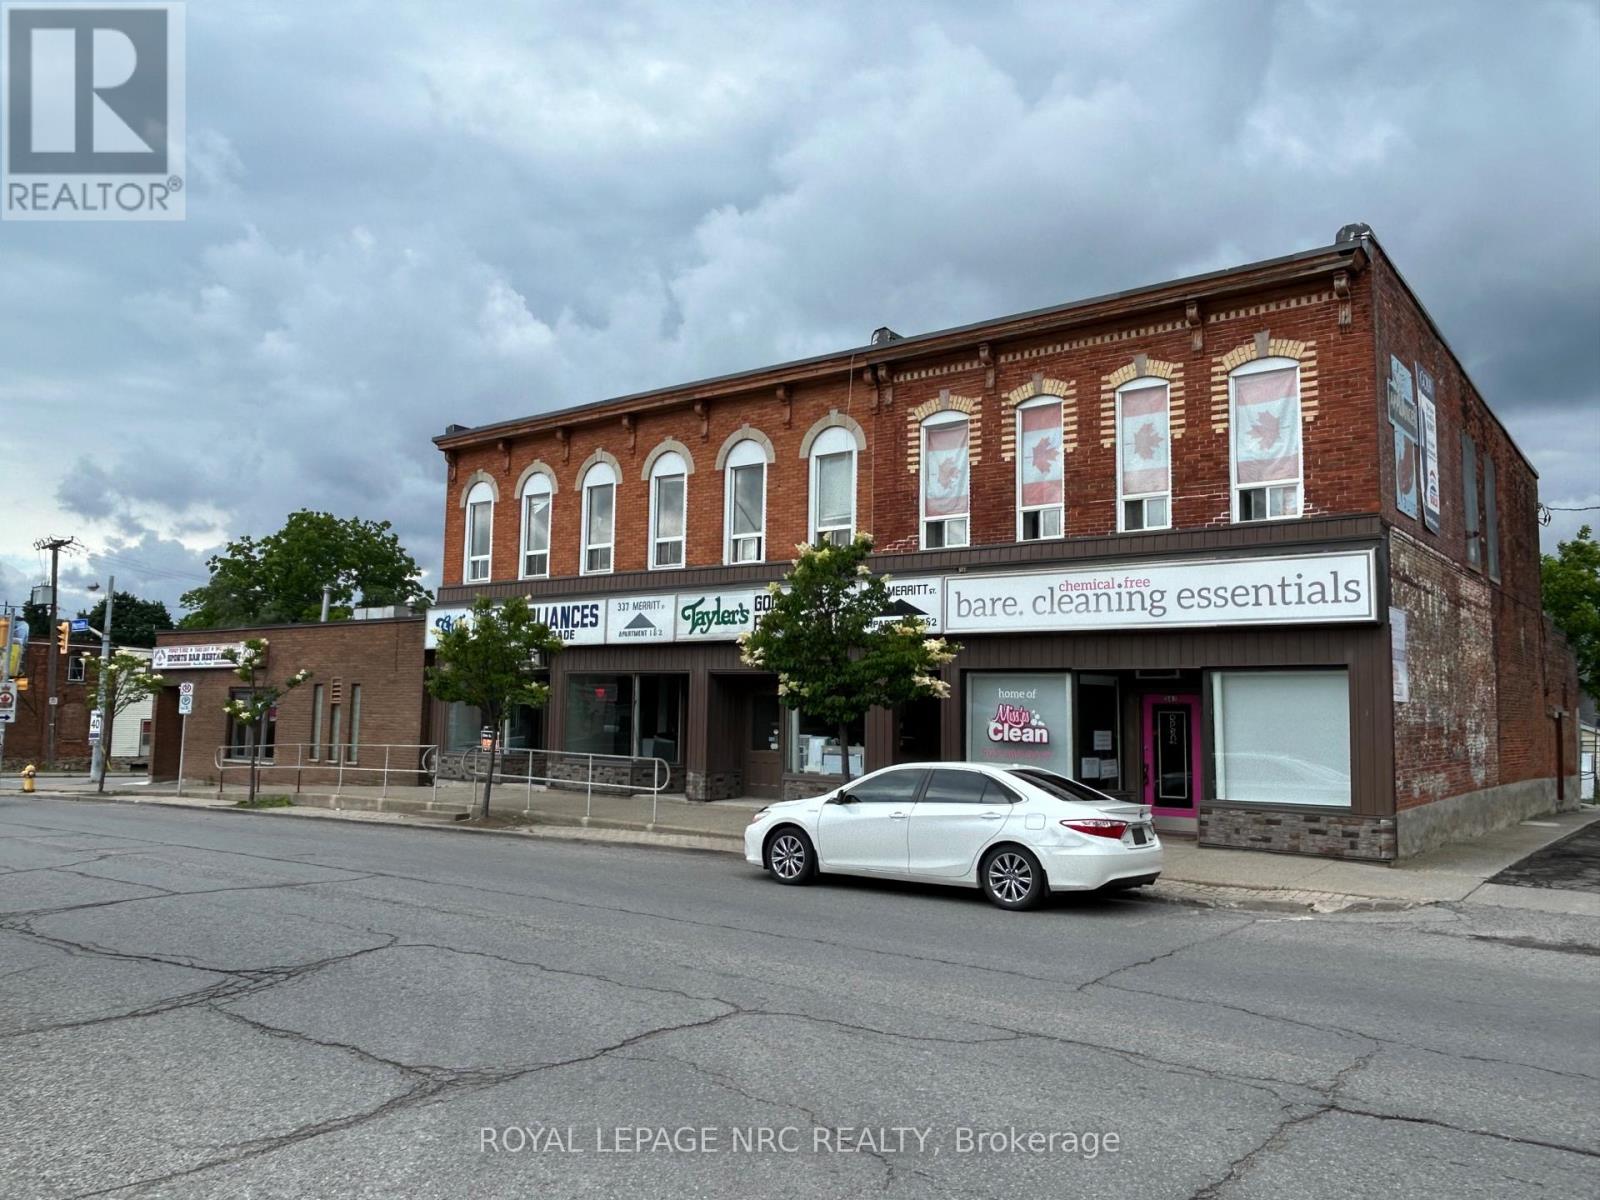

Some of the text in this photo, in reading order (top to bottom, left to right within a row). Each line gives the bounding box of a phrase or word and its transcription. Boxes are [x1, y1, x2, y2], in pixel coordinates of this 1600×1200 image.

[887, 584, 928, 595] MERRITT
[1059, 577, 1151, 592] chemical free
[955, 571, 1361, 618] bare. cleaning essentials
[617, 602, 630, 611] 337
[632, 600, 661, 610] MERRITT
[681, 596, 750, 635] Tayler's
[167, 654, 188, 662] SPORTS
[189, 653, 201, 661] BAR
[998, 688, 1037, 699] home of
[91, 719, 99, 728] 40
[988, 722, 1048, 743] Clean
